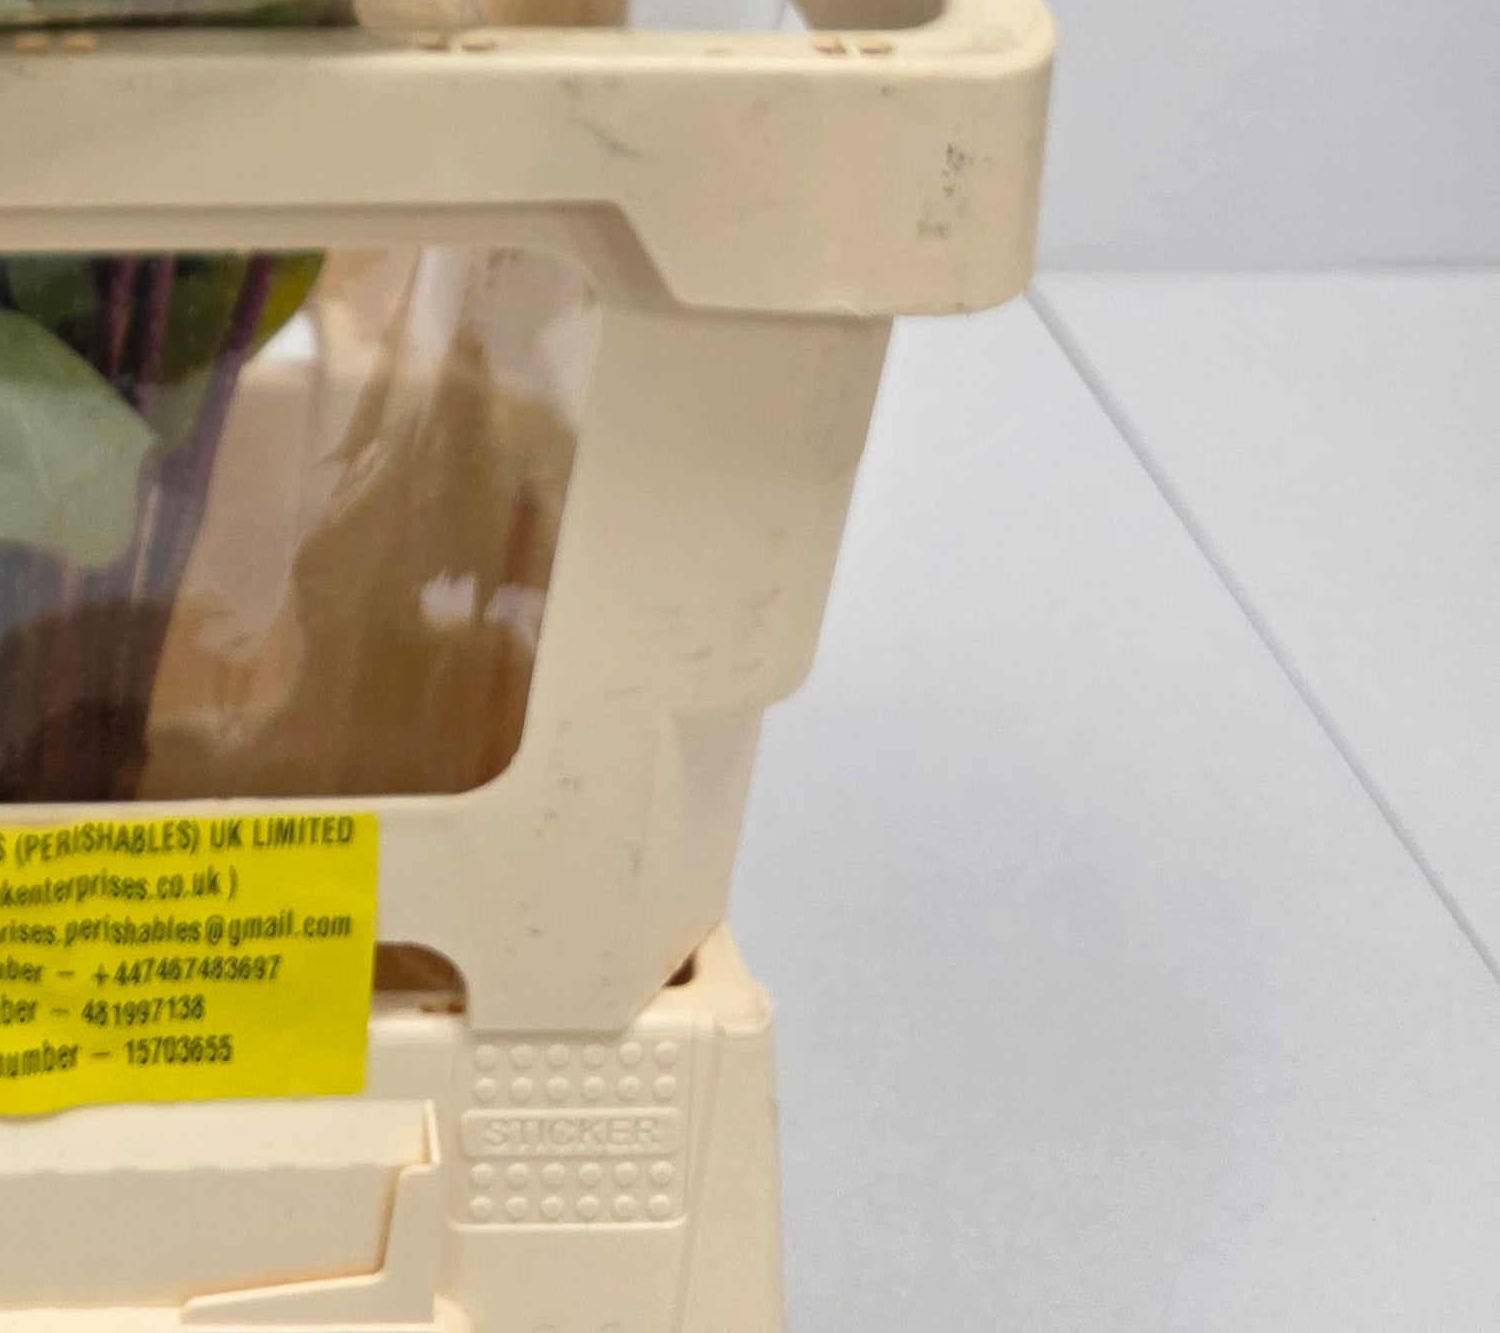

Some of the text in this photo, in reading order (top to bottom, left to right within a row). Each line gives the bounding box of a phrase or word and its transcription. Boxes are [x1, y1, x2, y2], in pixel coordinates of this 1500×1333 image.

[14, 819, 200, 866] (PERISHABLES)
[210, 819, 244, 849] UK
[252, 816, 355, 848] LIMITED
[124, 1034, 234, 1064] 15703655
[484, 1116, 664, 1154] STICKER
